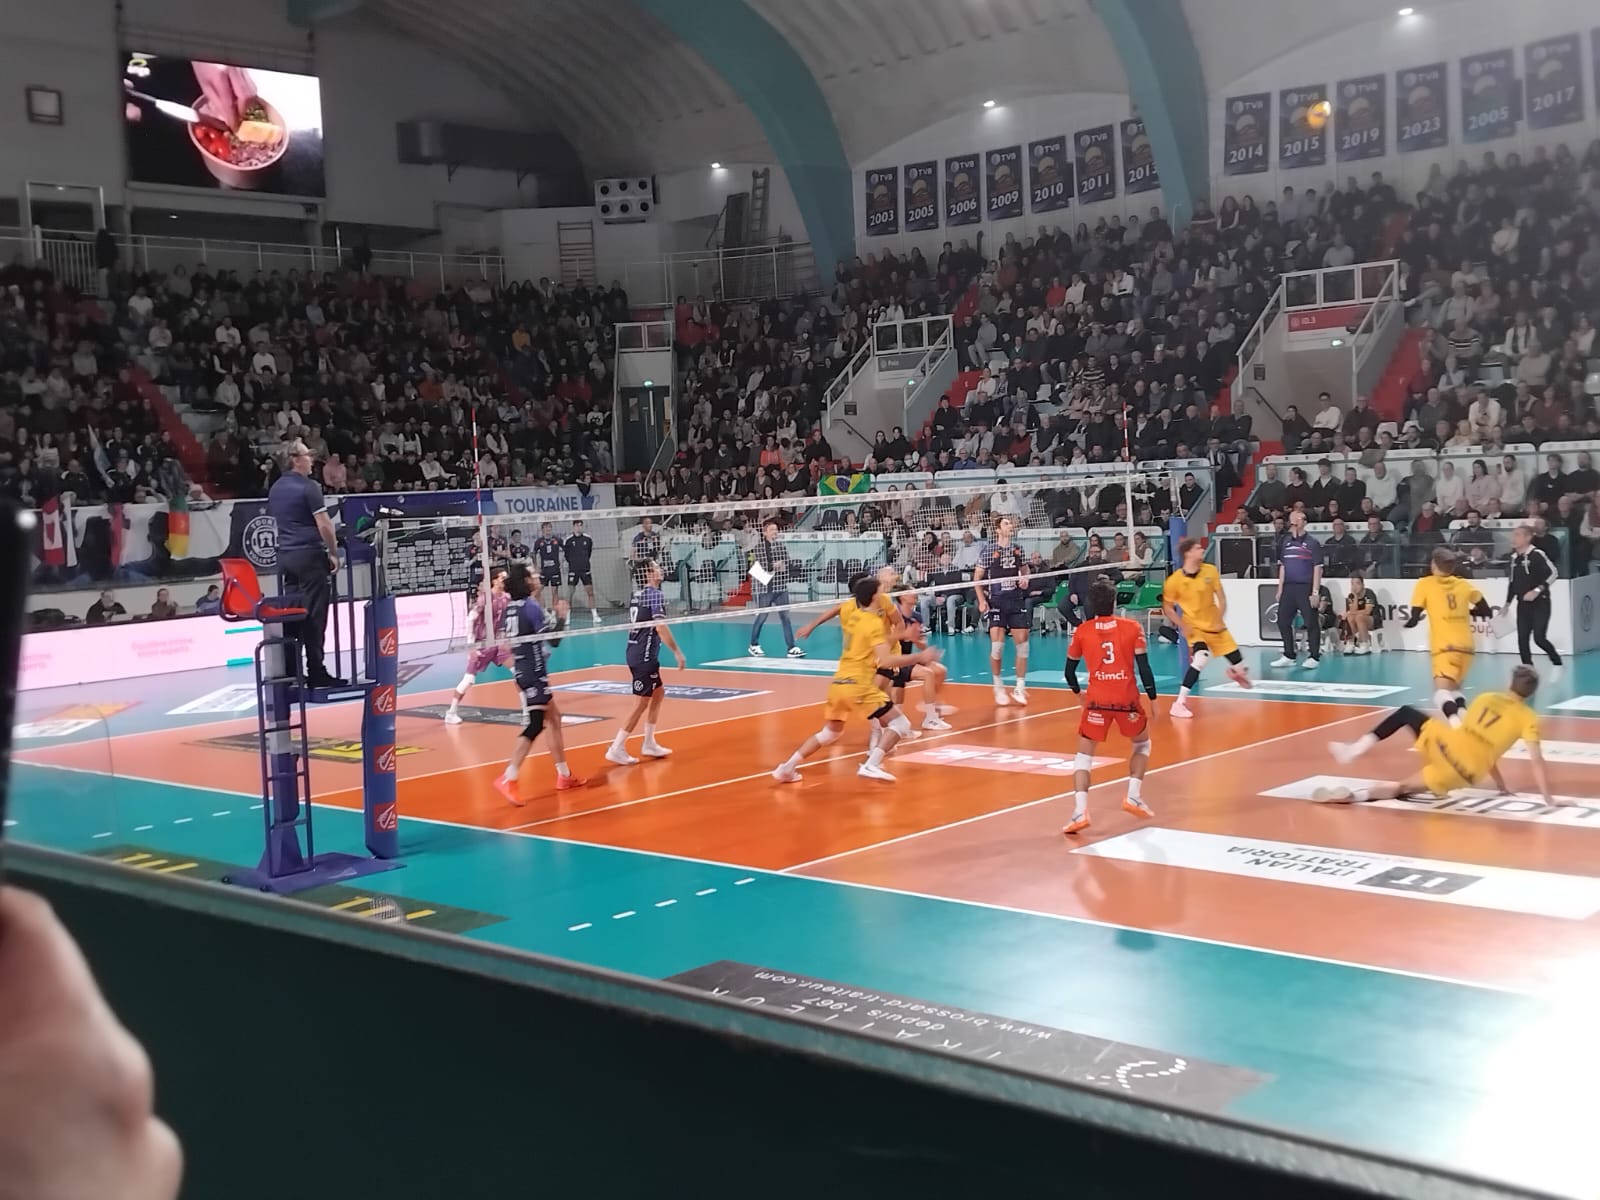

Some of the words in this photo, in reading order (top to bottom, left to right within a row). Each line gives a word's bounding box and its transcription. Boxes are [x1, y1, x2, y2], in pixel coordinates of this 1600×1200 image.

[1531, 87, 1575, 112] 2017
[1467, 106, 1510, 130] 2005
[1401, 117, 1441, 140] 2023
[1283, 136, 1320, 158] 2015
[1341, 128, 1380, 150] 2019
[1228, 144, 1264, 164] 2014
[1033, 182, 1064, 203] 2010
[1080, 173, 1110, 193] 2011
[949, 198, 977, 217] 2006
[990, 191, 1019, 211] 2009
[869, 210, 895, 226] 2003
[907, 204, 934, 222] 2005
[505, 496, 579, 513] TOURAINE
[1002, 556, 1017, 569] 22
[1446, 593, 1458, 611] 8
[1101, 641, 1115, 664] 3
[1476, 706, 1502, 729] 17
[1226, 845, 1372, 870] TRATTORIA
[1245, 857, 1357, 877] ITALIAN
[754, 971, 1052, 1040] www.brossard-traiteur.com
[801, 996, 858, 1013] 1967
[866, 1008, 945, 1031] depuis
